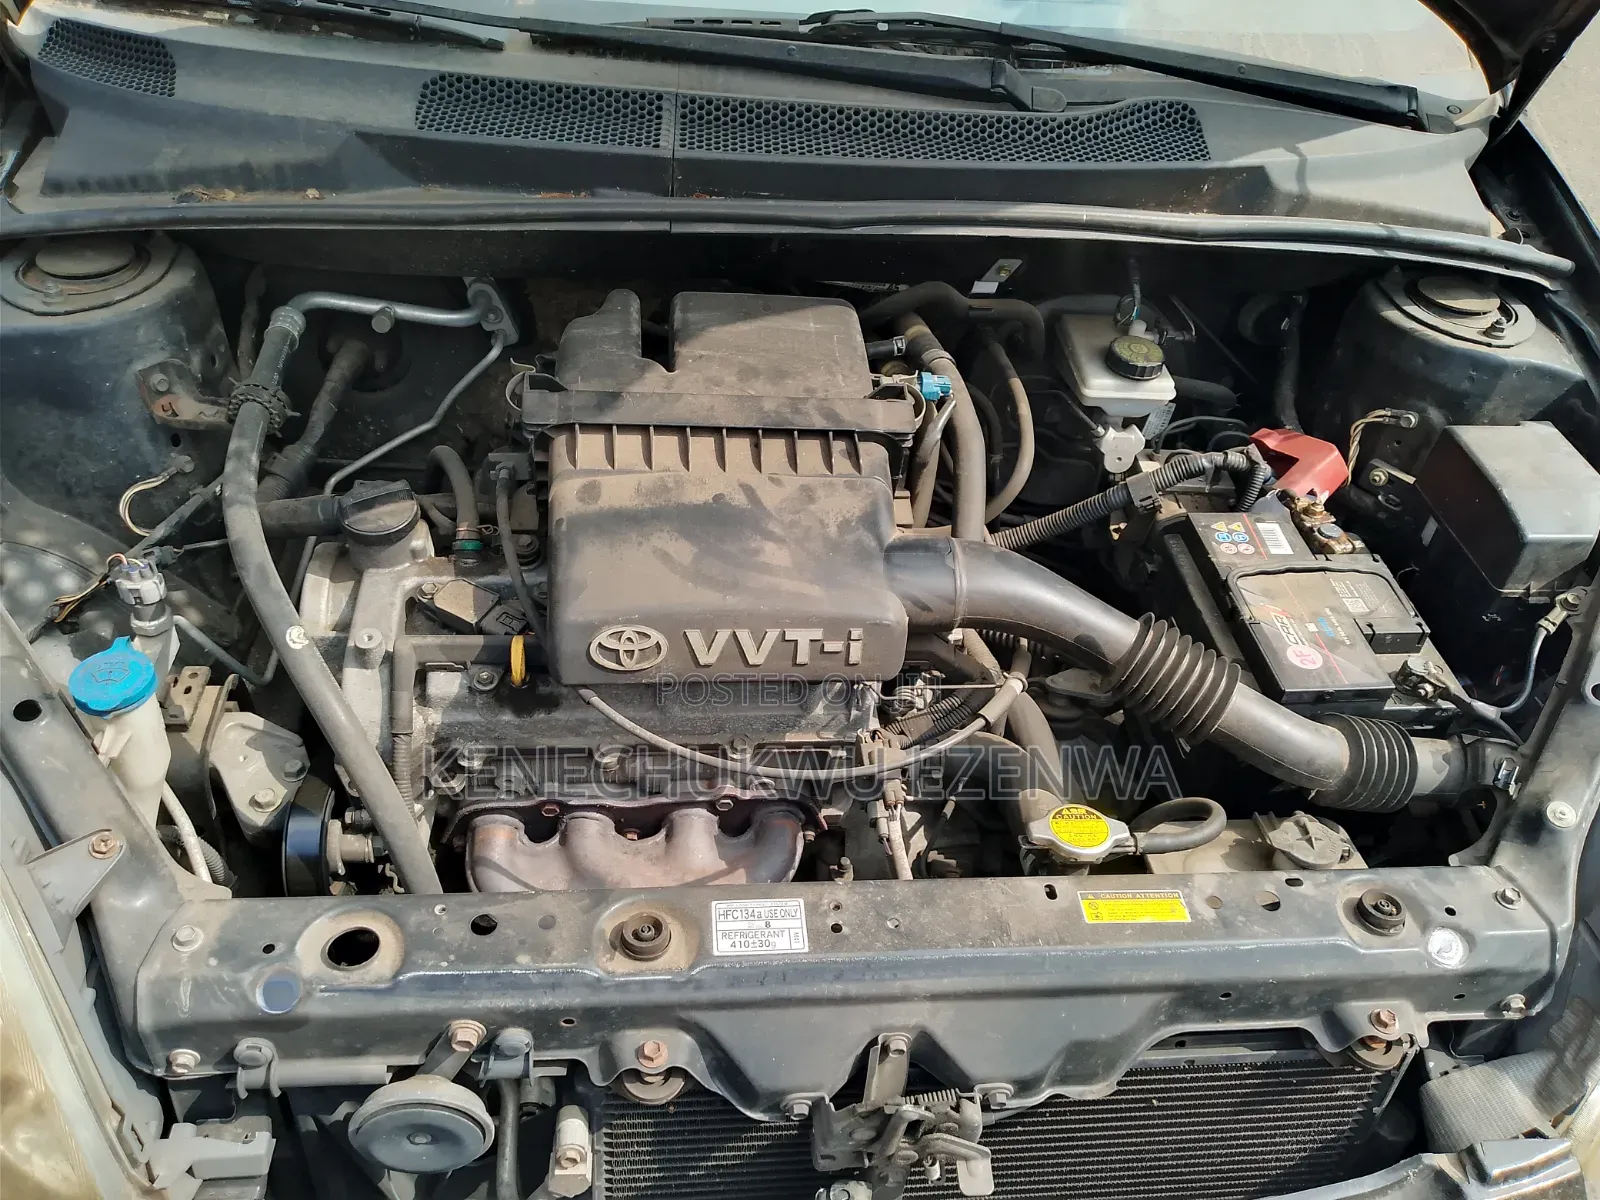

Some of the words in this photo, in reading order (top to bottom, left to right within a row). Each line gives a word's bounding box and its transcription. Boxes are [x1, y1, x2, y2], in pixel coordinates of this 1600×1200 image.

[682, 628, 864, 666] VVT-i
[718, 909, 762, 920] HFC134a
[764, 908, 778, 918] USE
[779, 908, 798, 918] ONLY
[765, 921, 771, 929] 8
[721, 930, 785, 940] REFRIGERANT
